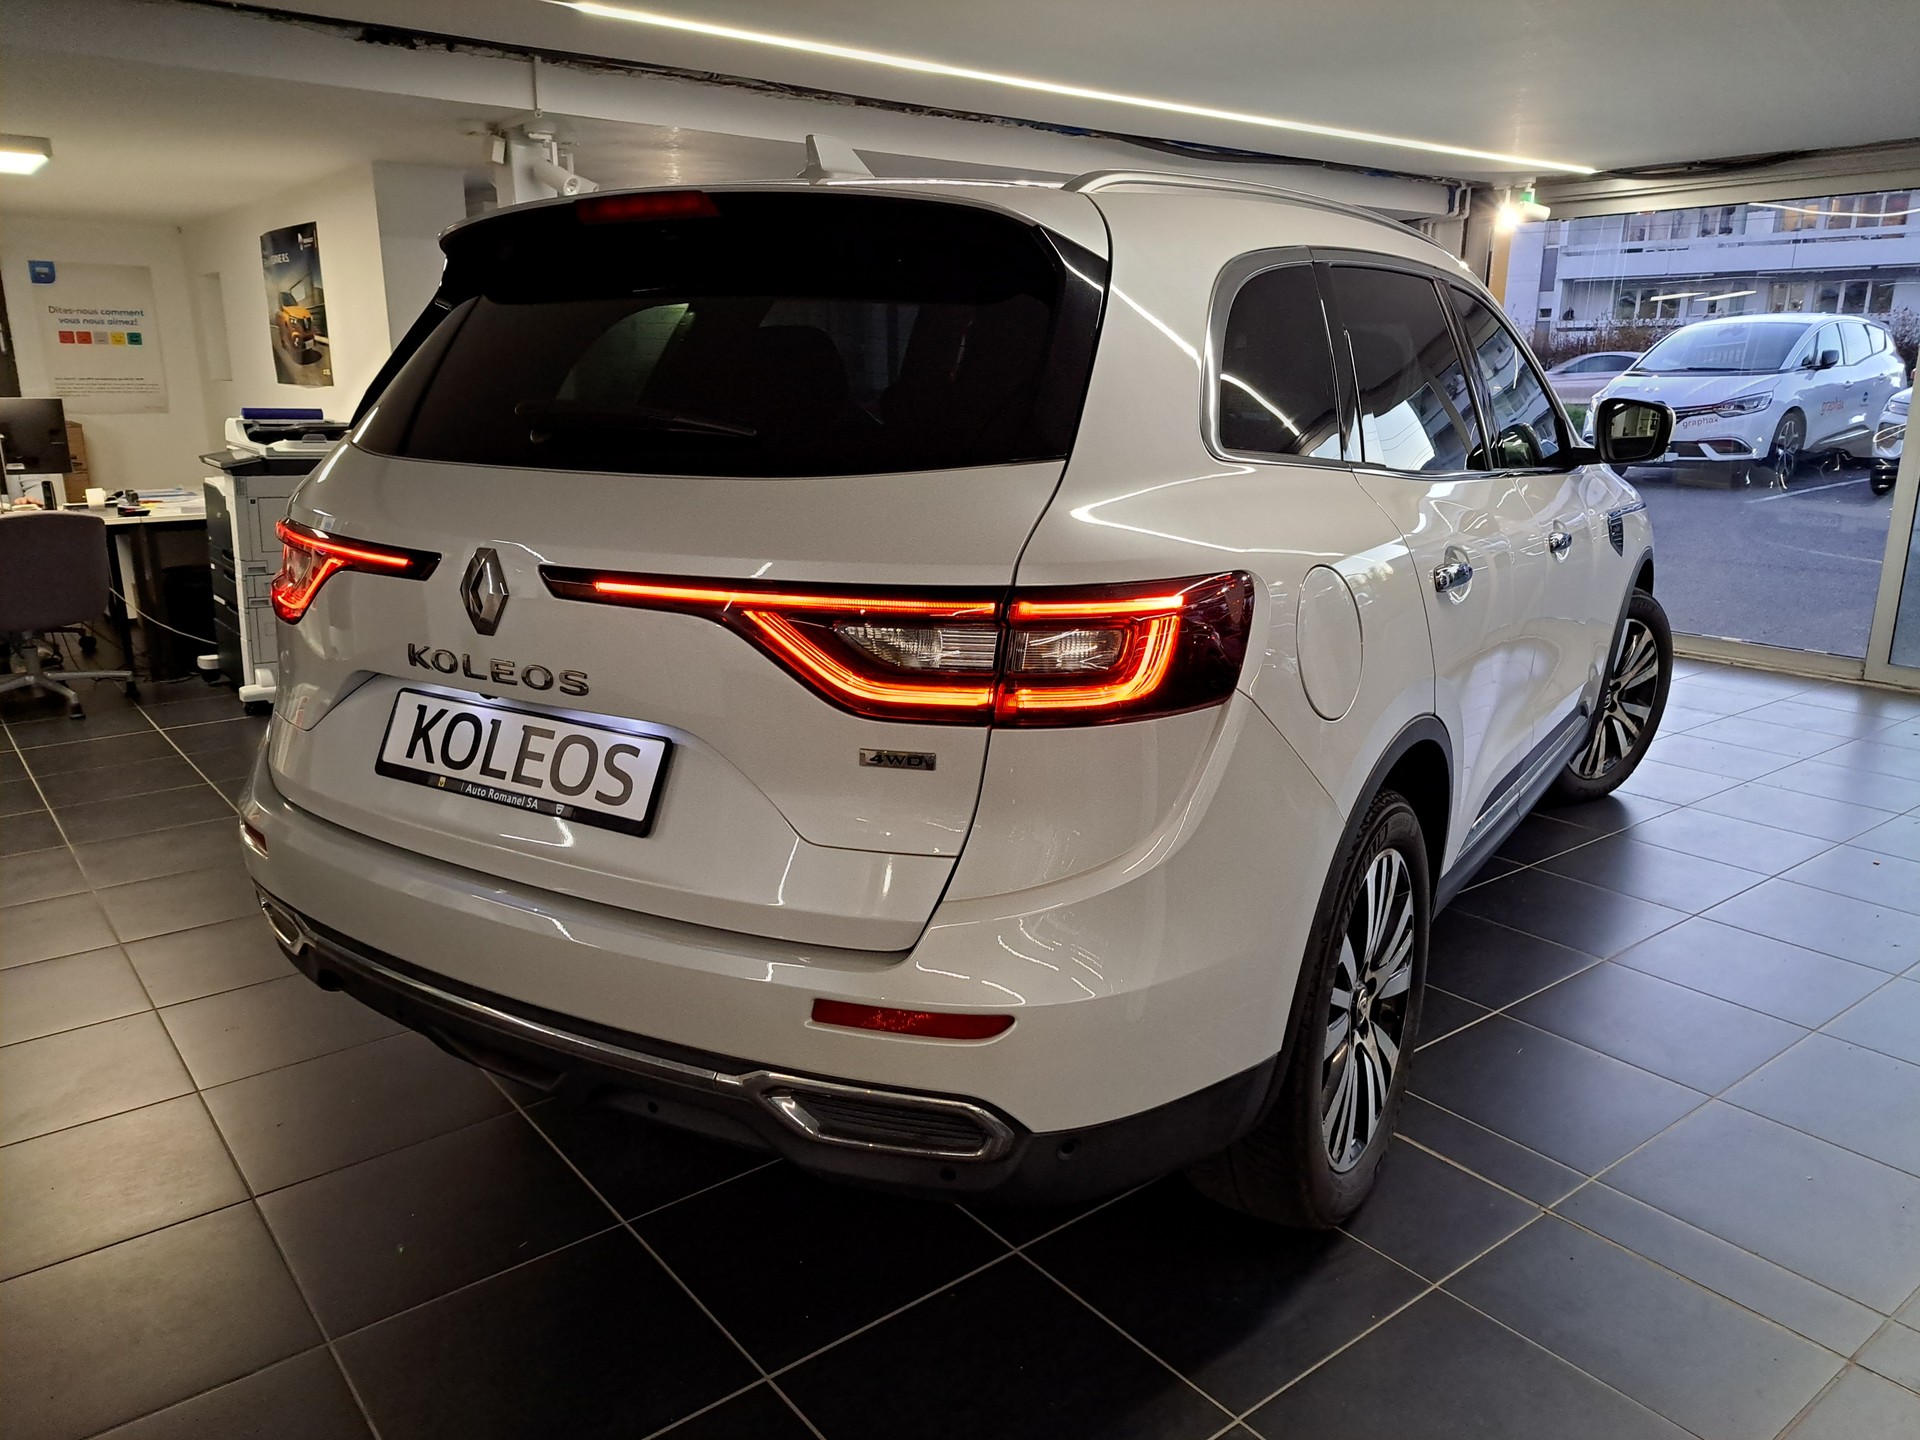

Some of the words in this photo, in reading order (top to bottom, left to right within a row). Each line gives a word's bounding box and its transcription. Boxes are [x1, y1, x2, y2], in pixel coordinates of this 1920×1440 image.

[48, 305, 98, 315] Dites-nous
[100, 308, 145, 317] comment
[1682, 415, 1719, 429] graphax
[407, 643, 590, 697] KOLEOS
[405, 703, 641, 807] KOLEOS
[869, 754, 925, 767] 4WD
[465, 783, 486, 797] Auto
[488, 788, 525, 806] Romanel
[526, 798, 539, 810] SA
